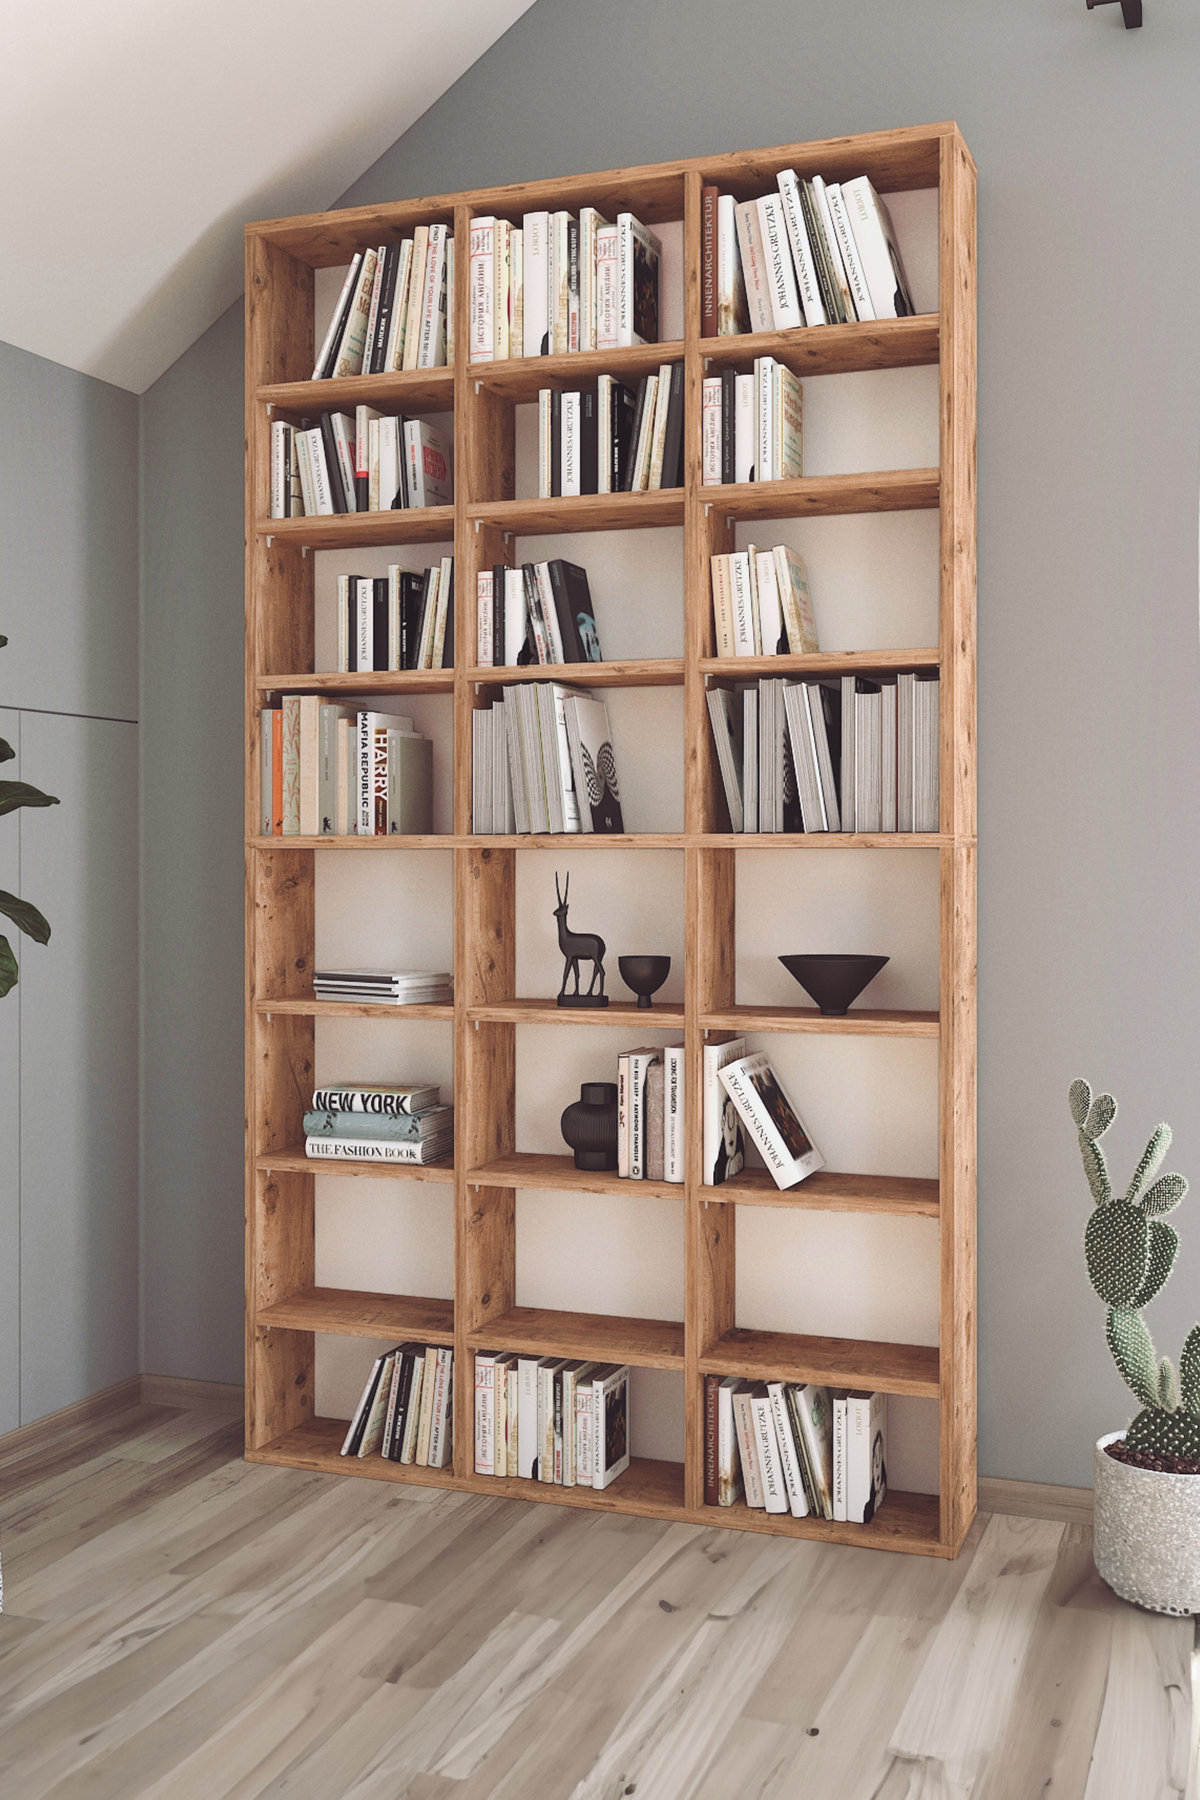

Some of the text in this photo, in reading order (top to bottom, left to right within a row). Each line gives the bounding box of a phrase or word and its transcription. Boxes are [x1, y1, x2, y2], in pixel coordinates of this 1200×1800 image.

[852, 188, 869, 221] LORIOT
[532, 222, 540, 256] LORIOT
[704, 195, 713, 317] INNENARCHITEKTUR
[764, 202, 790, 309] JOHANNES GRÜTZKE
[782, 179, 814, 303] JOHANNES GRÜTZKE
[831, 192, 866, 302] JOHANNES GRÜTZKE
[429, 275, 435, 284] OF
[619, 221, 627, 329] JOHANNES GRÜTZKE
[377, 318, 387, 348] МАЛЕЖИК
[423, 320, 431, 341] AFTER
[477, 302, 485, 343] ИСТОРИЯ
[566, 439, 574, 483] JOHANNES
[316, 468, 326, 506] JOHANNES
[735, 558, 748, 643] JOHANNES GRÜTZKE
[361, 713, 369, 808] MAFIA REPUBLIC
[374, 734, 388, 801] HARRY
[315, 1092, 408, 1115] NEW YORK
[727, 1071, 756, 1117] GRÜTZKE
[309, 1143, 417, 1160] THE FASHION BOOK
[751, 1117, 785, 1169] JOHANNES
[438, 1390, 443, 1398] OF
[707, 1382, 716, 1487] INNENARCHITEKTUR
[757, 1405, 778, 1496] JOHANNES GRÜTZKE
[772, 1390, 798, 1498] JOHANNES GRÜTZKE
